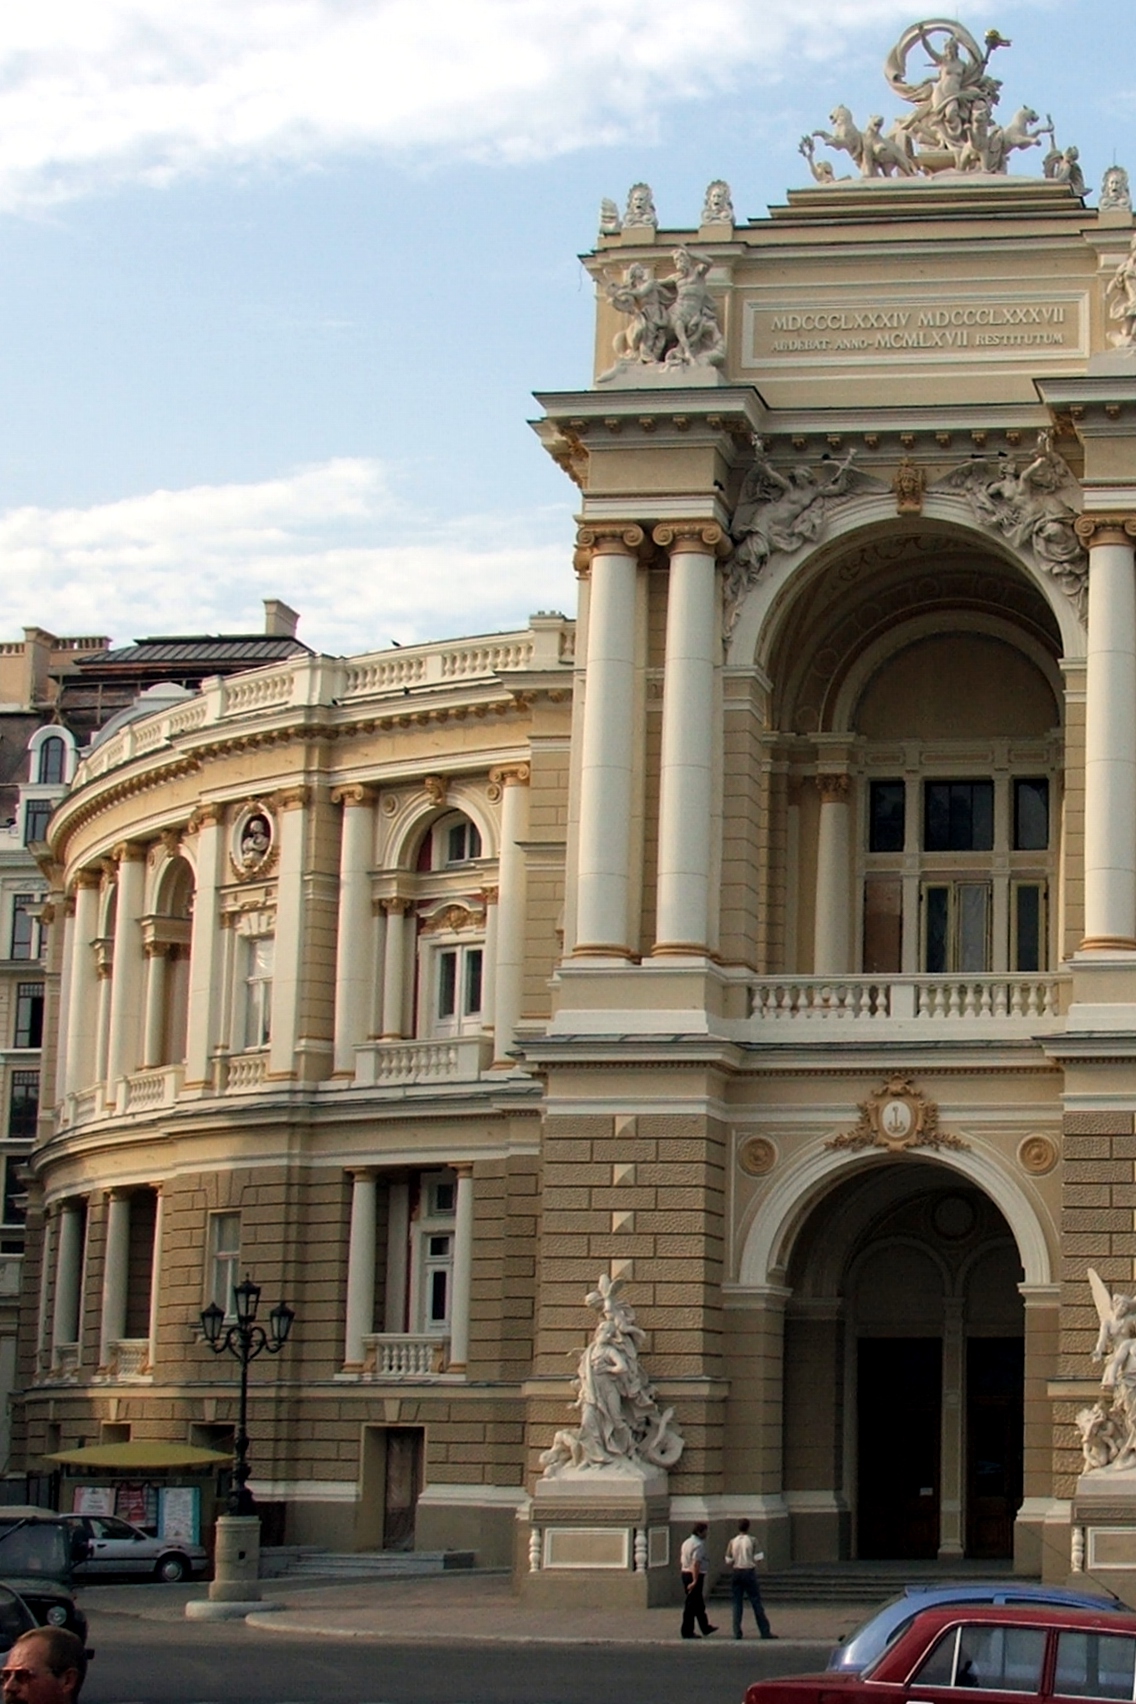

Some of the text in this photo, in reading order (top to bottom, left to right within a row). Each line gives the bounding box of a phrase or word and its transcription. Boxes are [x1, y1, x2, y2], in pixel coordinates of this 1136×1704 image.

[771, 307, 1064, 331] MDCCCLXXXIV MDCCCLXXXVII
[975, 333, 1064, 346] RESTITUTUM
